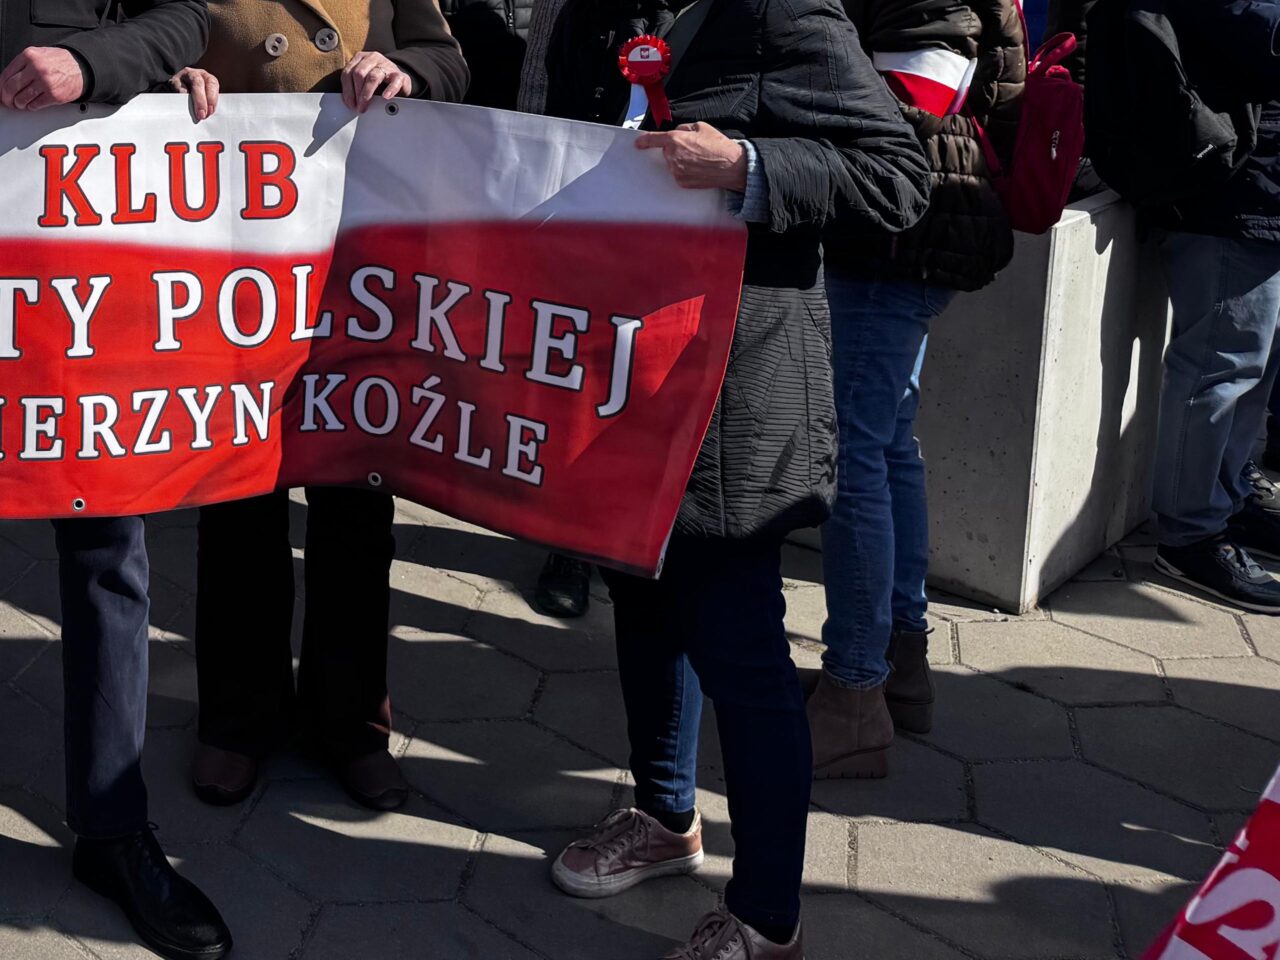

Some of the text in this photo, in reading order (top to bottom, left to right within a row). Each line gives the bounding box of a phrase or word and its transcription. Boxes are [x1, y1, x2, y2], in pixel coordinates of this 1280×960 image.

[37, 140, 299, 228] KLUB
[151, 264, 644, 419] POLSKIEJ
[300, 372, 549, 486] KOŹLE
